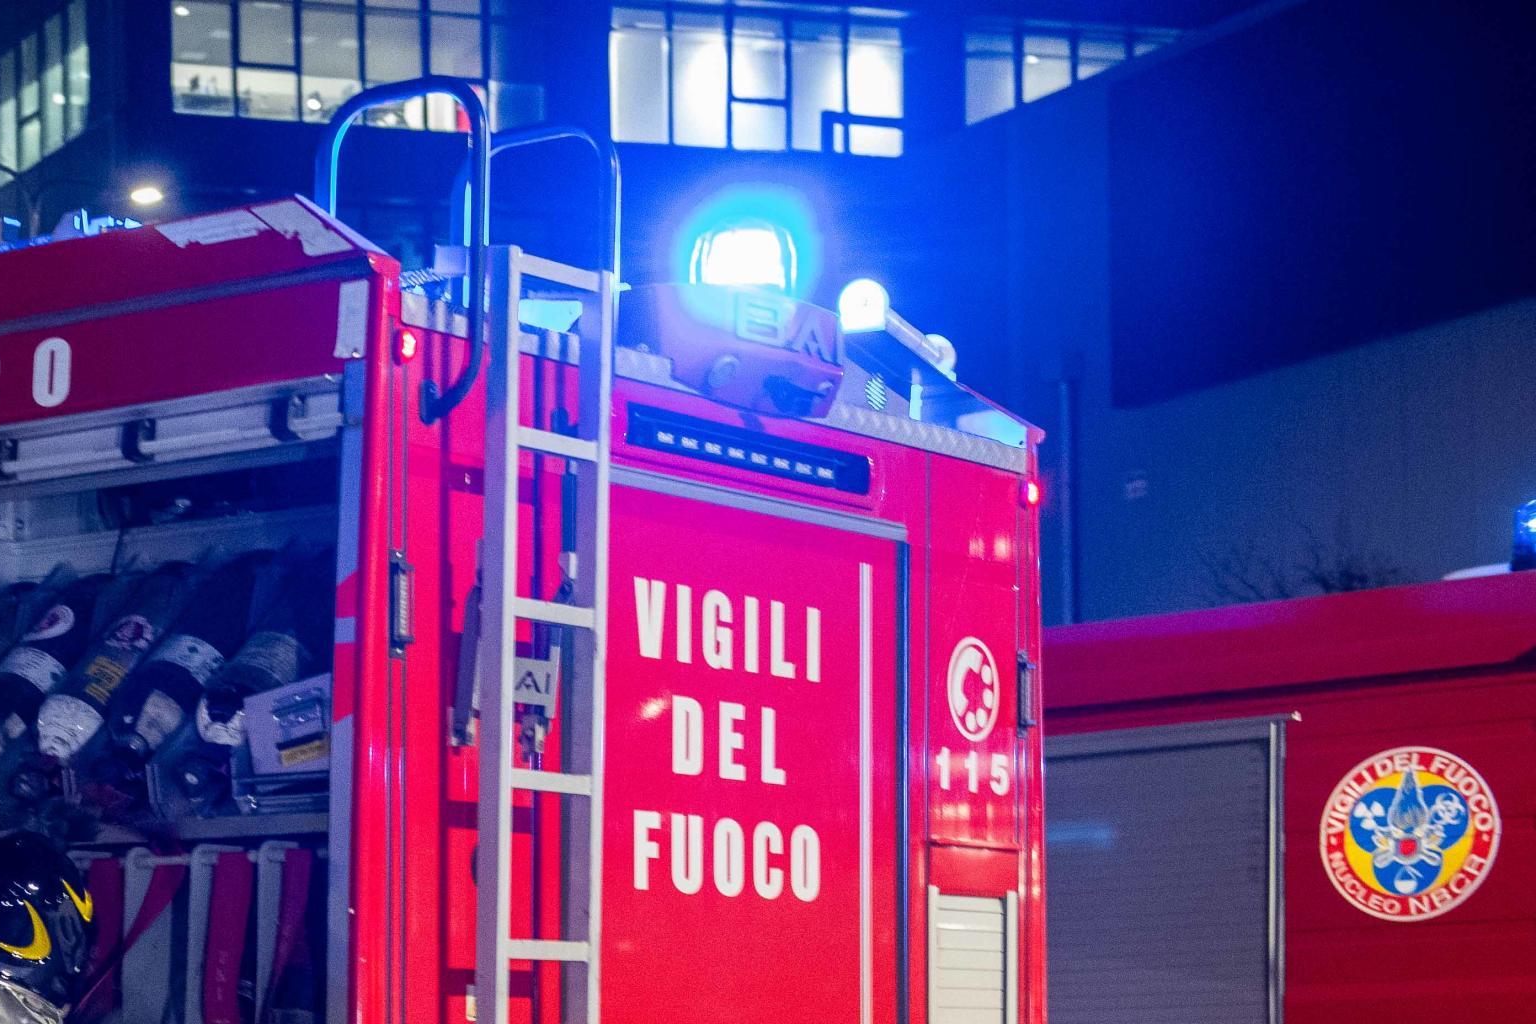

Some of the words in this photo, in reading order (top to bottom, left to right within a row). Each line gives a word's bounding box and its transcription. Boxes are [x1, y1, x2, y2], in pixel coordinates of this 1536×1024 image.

[632, 575, 822, 684] VIGILI
[514, 670, 551, 695] AI
[671, 694, 787, 786] DEL
[935, 746, 1011, 797] 115
[1327, 768, 1375, 834] VIGILI
[1374, 752, 1427, 776] DEL
[1429, 754, 1494, 833] FUOCO
[632, 808, 822, 903] FUOCO
[1329, 851, 1402, 914] NUCLEO
